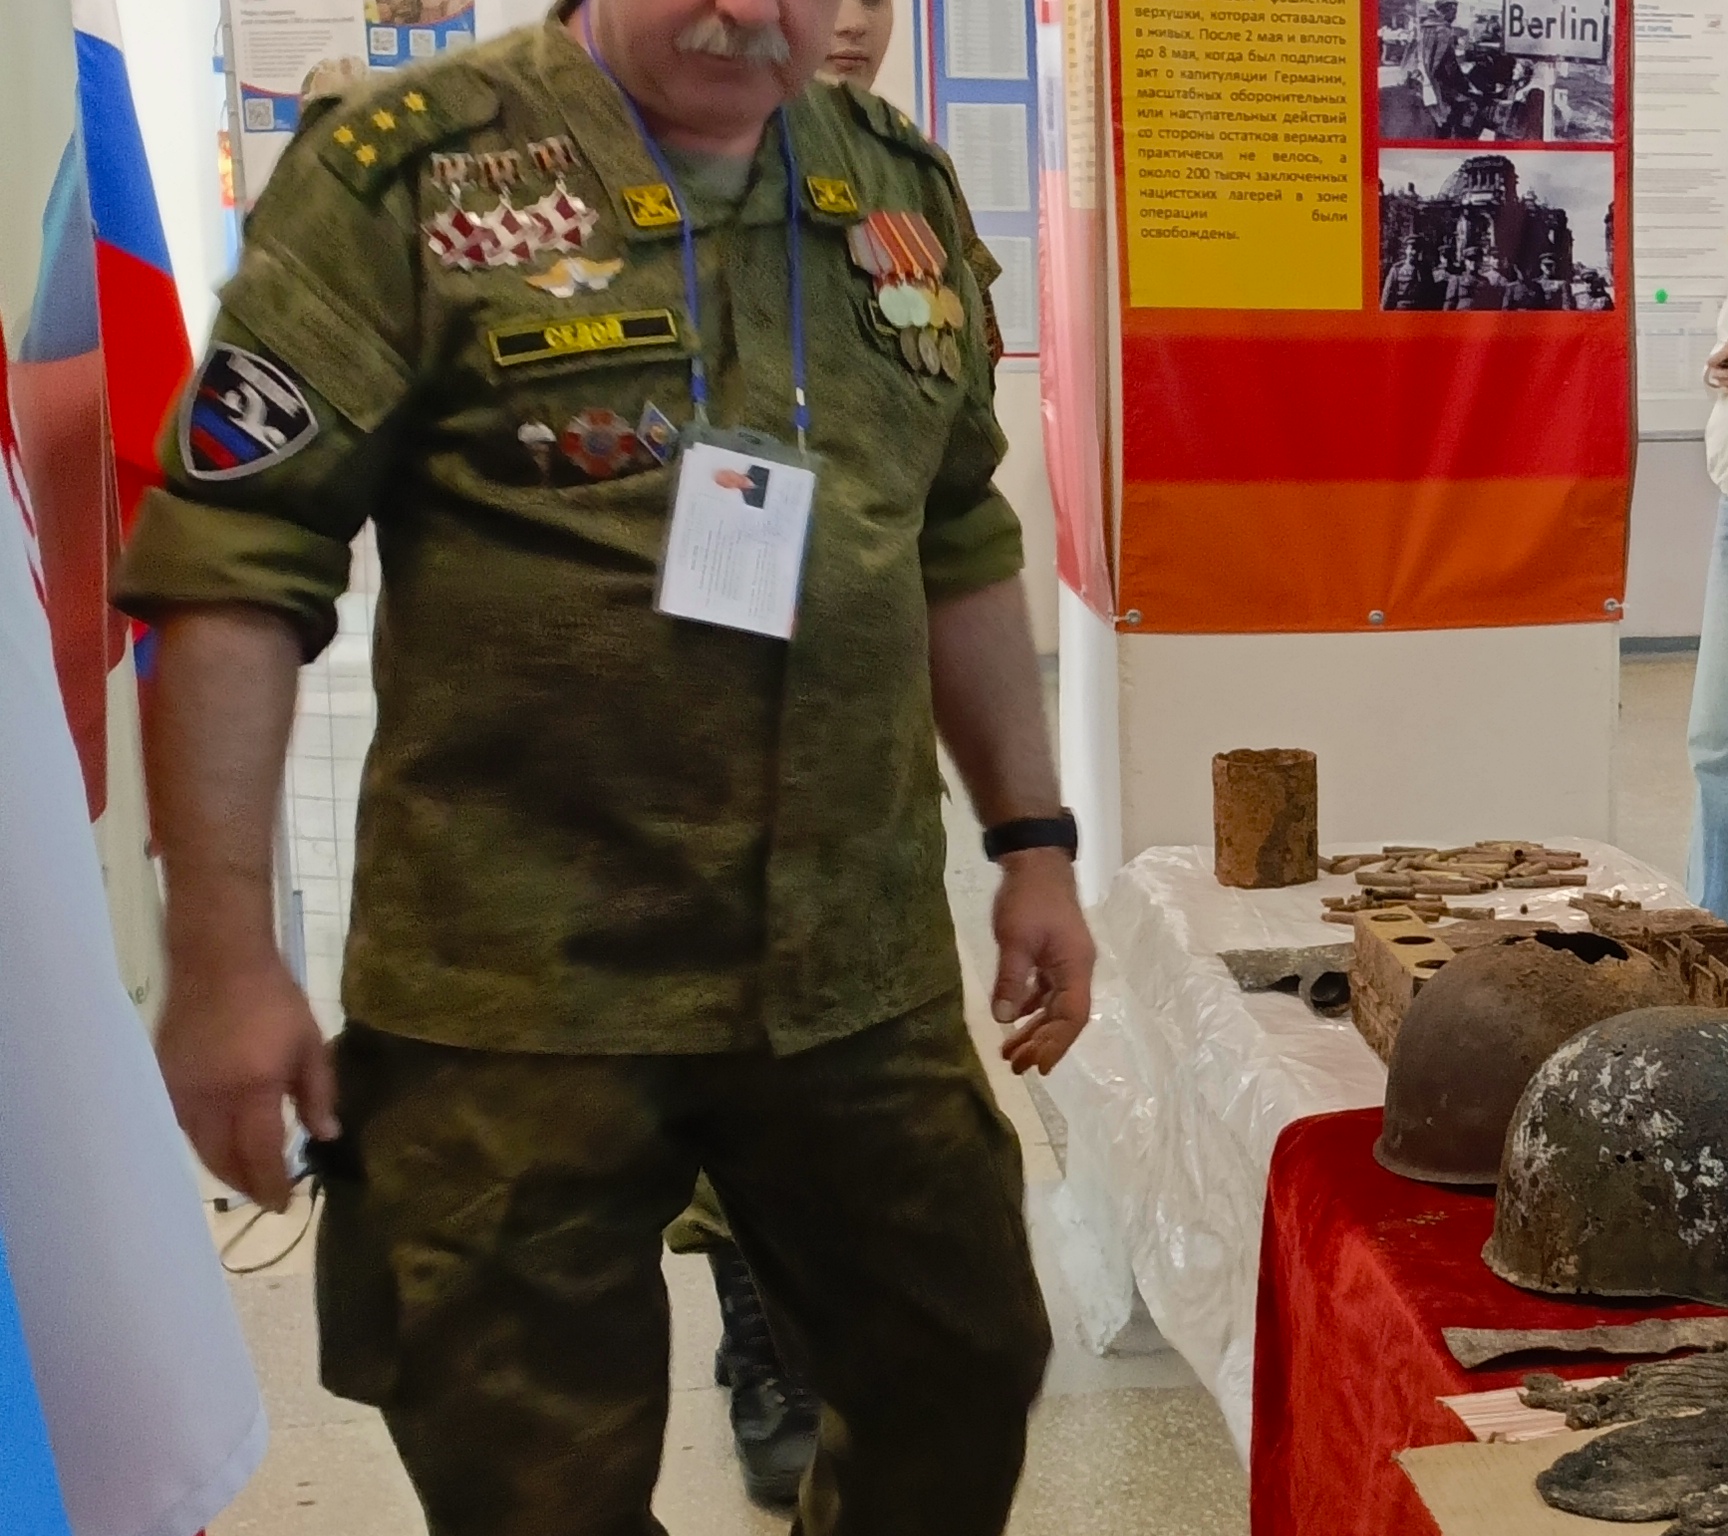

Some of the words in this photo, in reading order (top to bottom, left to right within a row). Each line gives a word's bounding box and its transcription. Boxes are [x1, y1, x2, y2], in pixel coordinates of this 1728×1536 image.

[1210, 10, 1265, 24] которая
[1270, 12, 1346, 25] оставалась
[1508, 3, 1599, 43] Berlin
[1199, 27, 1241, 41] После
[1256, 32, 1283, 42] мая
[1299, 33, 1346, 45] вплоть
[1134, 47, 1154, 59] до
[1204, 50, 1243, 63] когда
[1247, 48, 1276, 62] был
[1280, 53, 1346, 65] подписан
[1135, 67, 1158, 78] акт
[1180, 70, 1267, 83] капитуляции
[1229, 88, 1347, 104] оборонительных
[1136, 108, 1163, 118] или
[1169, 109, 1277, 122] наступательных
[1281, 110, 1347, 124] действий
[1137, 128, 1153, 138] со
[1157, 128, 1215, 141] стороны
[1218, 130, 1279, 142] остатков
[1283, 132, 1347, 145] вермахта
[1137, 147, 1223, 160] практически
[1238, 151, 1256, 161] не
[1138, 167, 1180, 178] около
[1185, 166, 1210, 179] 200
[1255, 171, 1347, 182] заключенных
[1139, 188, 1217, 199] нацистских
[1228, 188, 1282, 203] лагерей
[1316, 192, 1347, 203] зоне
[1139, 208, 1207, 220] операции
[1311, 208, 1347, 222] были
